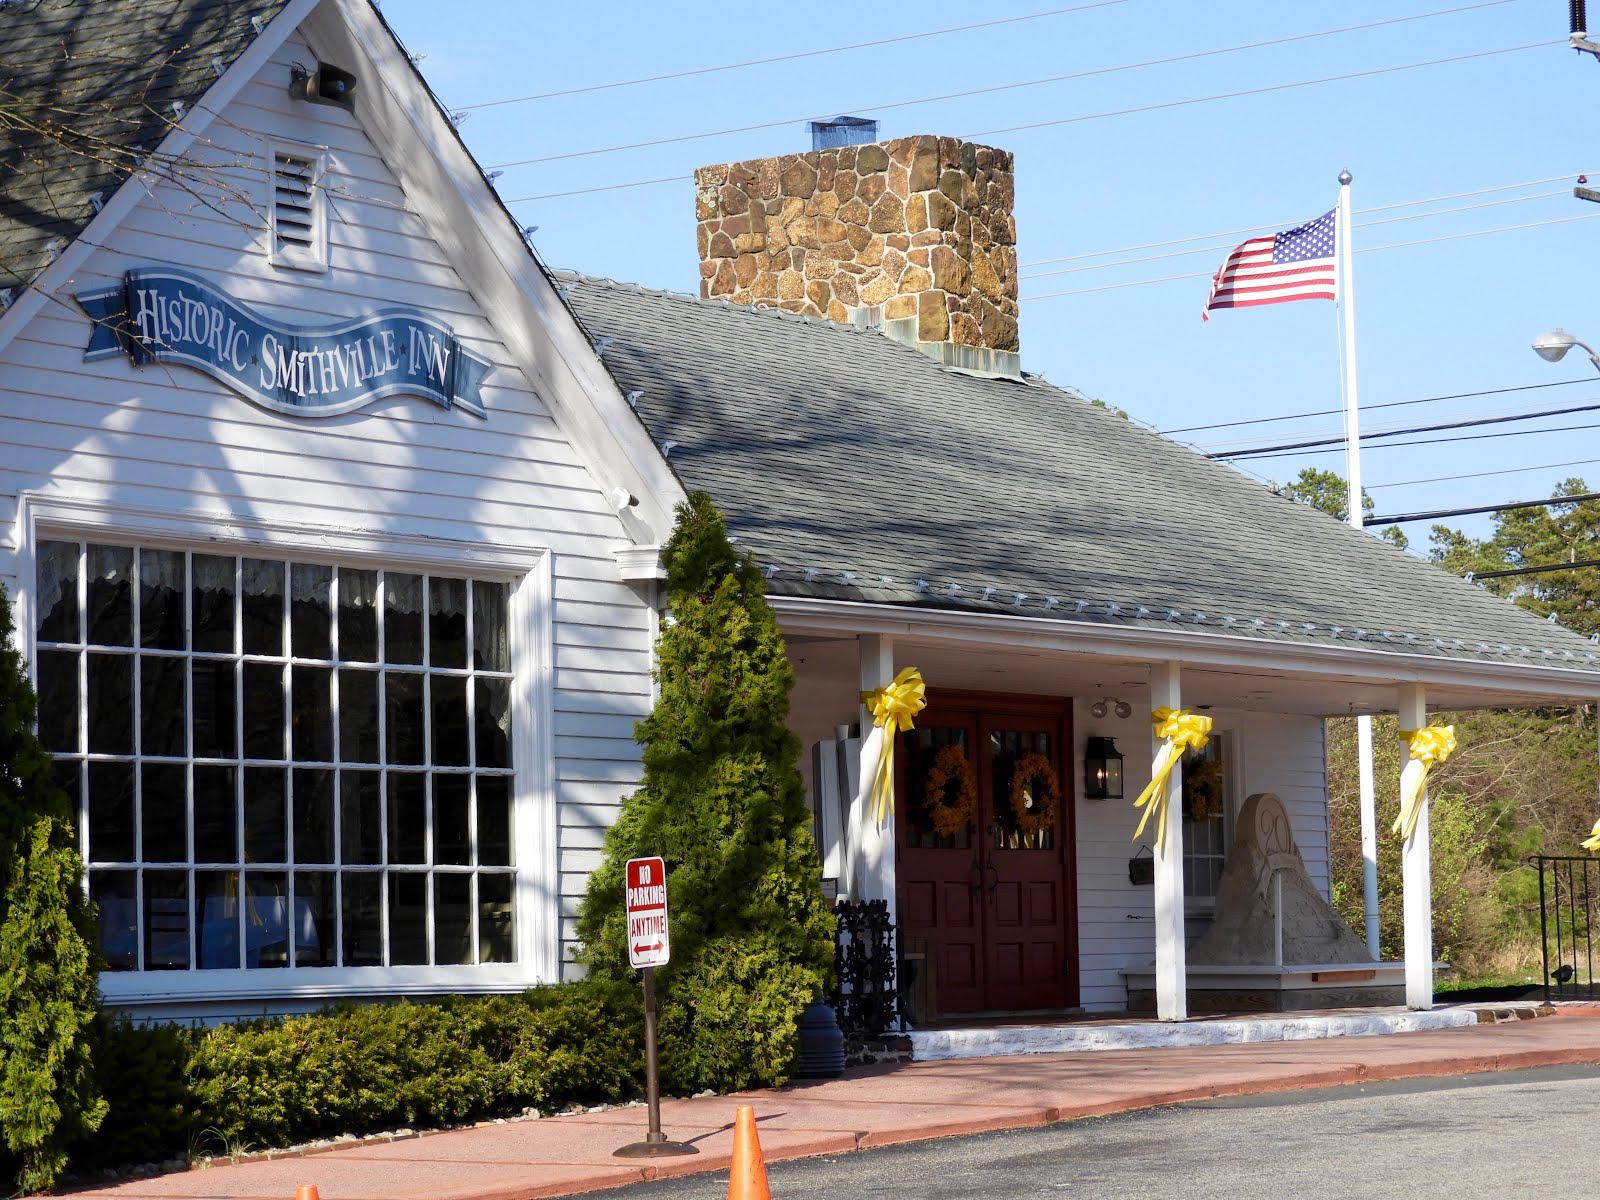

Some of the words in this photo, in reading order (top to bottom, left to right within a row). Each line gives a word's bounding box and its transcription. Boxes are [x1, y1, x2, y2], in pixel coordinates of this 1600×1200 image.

[136, 290, 250, 372] HISTORIC
[259, 329, 399, 397] SMITHVILLE
[407, 325, 450, 387] INN
[638, 864, 651, 885] NO
[628, 884, 665, 907] PARKING
[631, 915, 665, 938] ANYTIME
